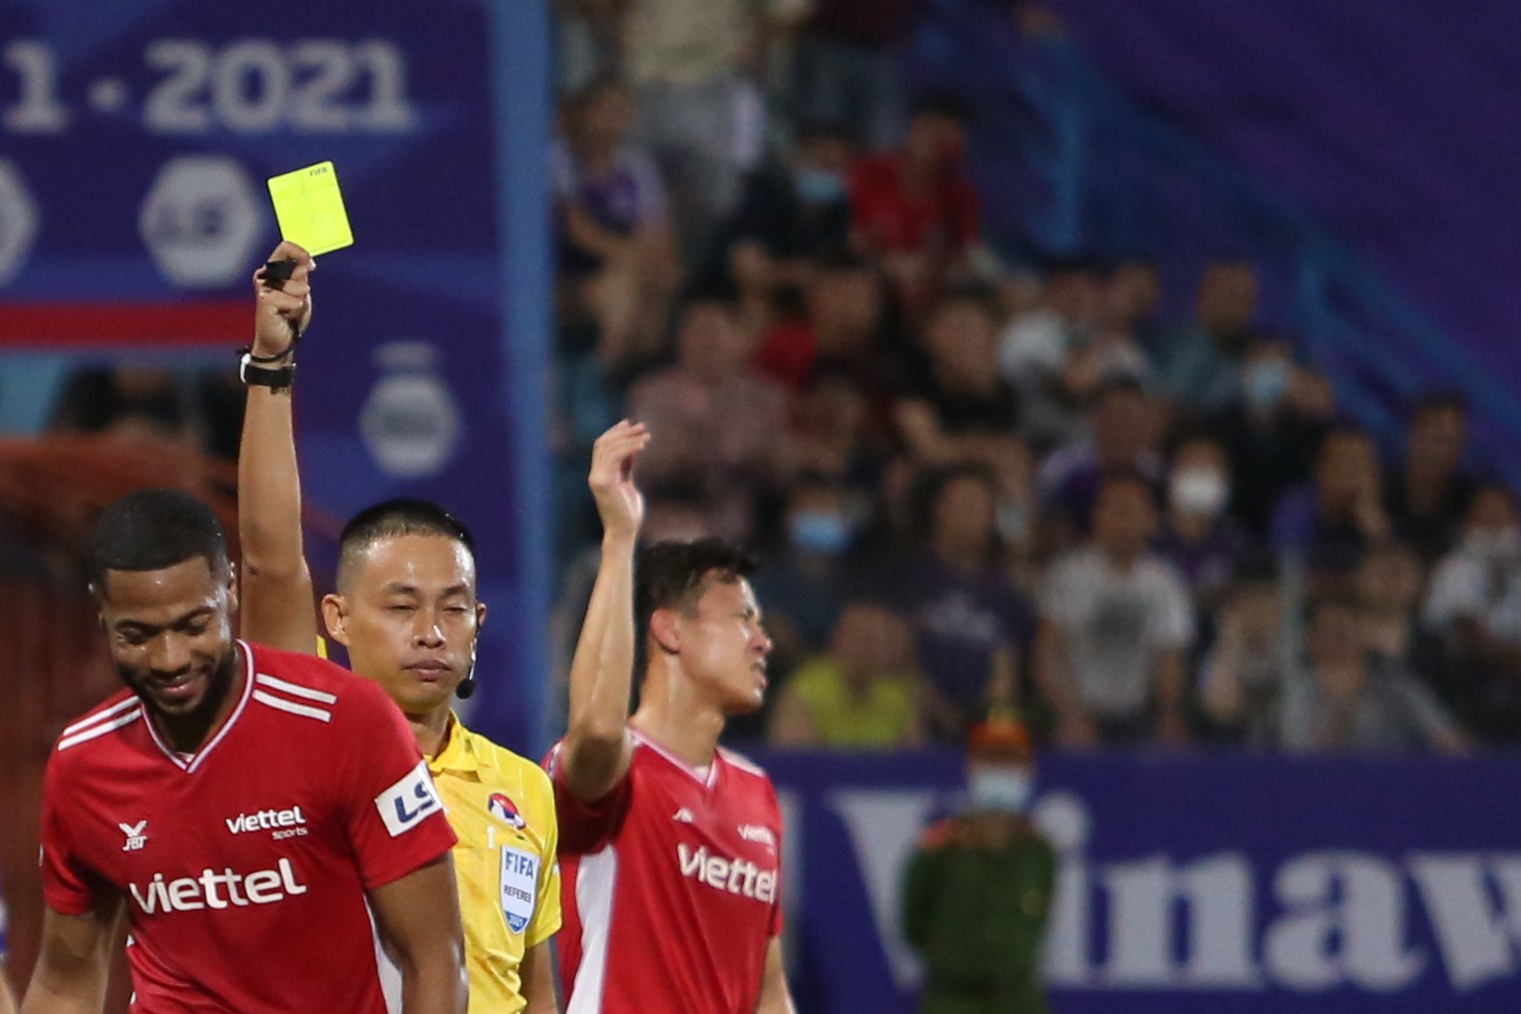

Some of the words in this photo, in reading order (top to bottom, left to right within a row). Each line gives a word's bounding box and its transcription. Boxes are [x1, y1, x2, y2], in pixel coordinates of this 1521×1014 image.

[4, 39, 71, 130] 1
[144, 39, 415, 131] 2021
[226, 806, 306, 834] viettel
[272, 827, 308, 840] sports
[505, 852, 534, 879] FIFA
[129, 858, 307, 914] viettel
